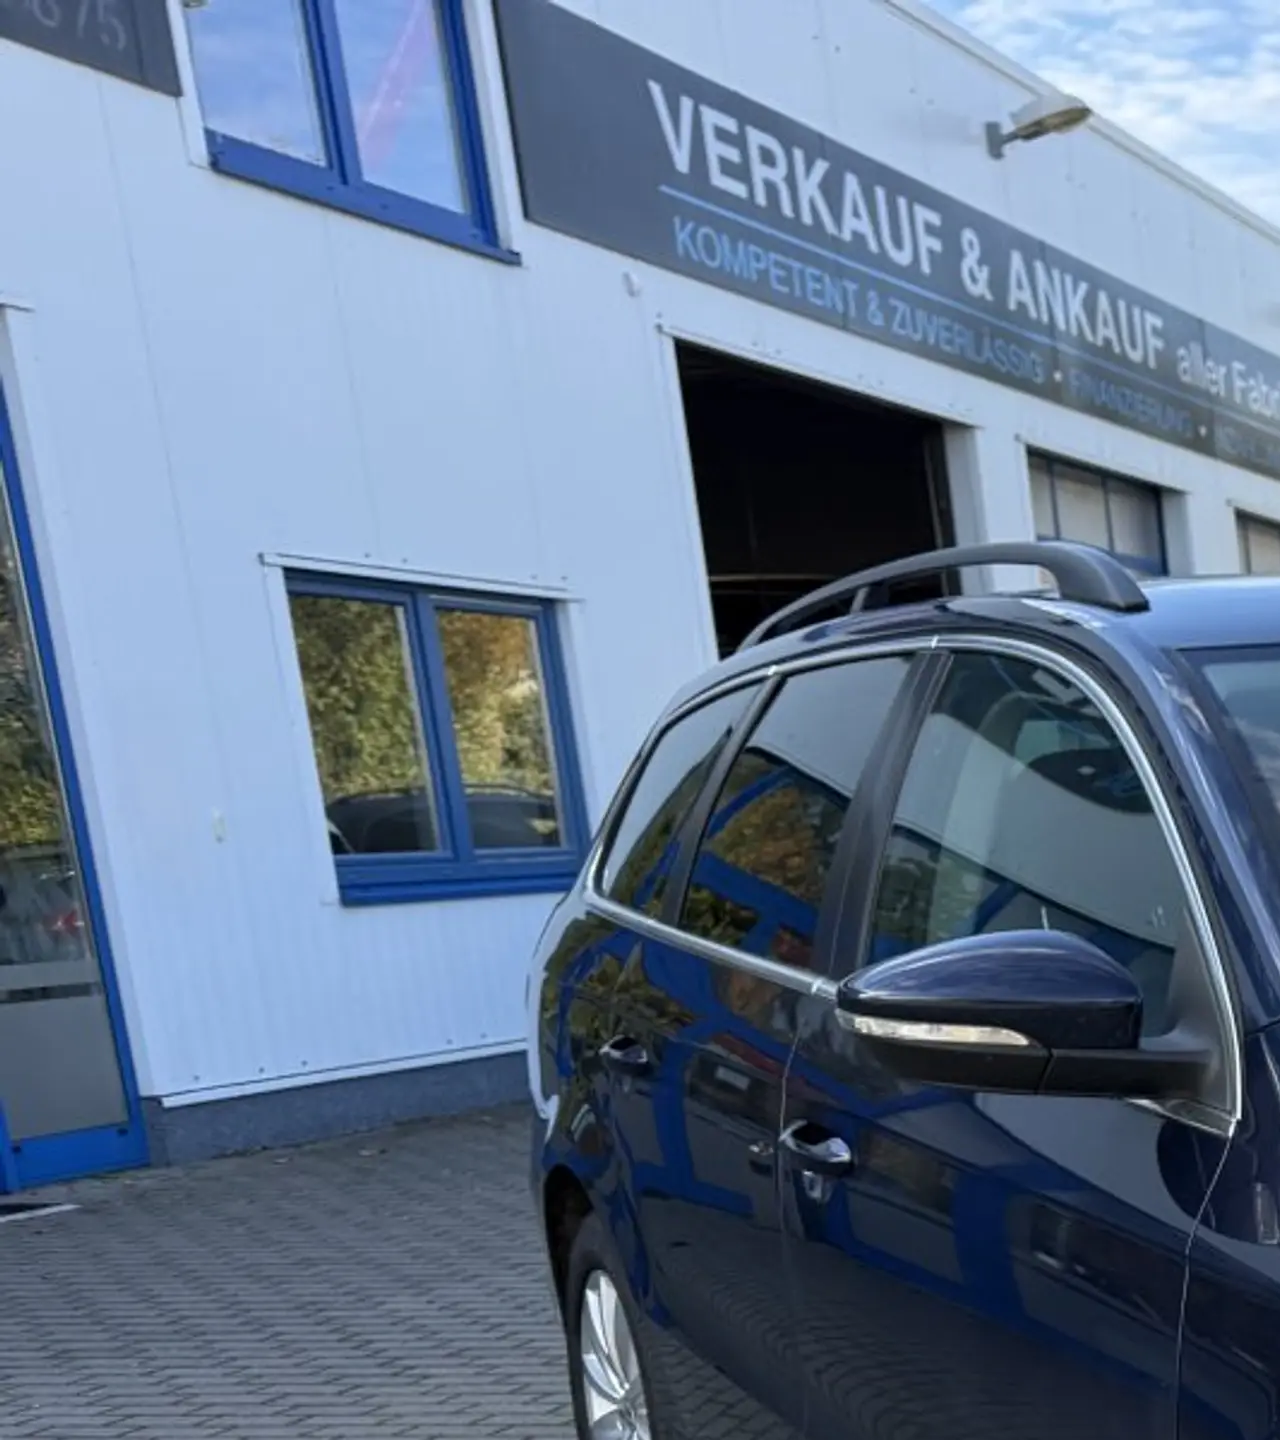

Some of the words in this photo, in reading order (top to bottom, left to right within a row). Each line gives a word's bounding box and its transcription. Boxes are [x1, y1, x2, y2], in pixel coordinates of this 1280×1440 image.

[647, 79, 943, 275] VERKAUF
[960, 227, 994, 302] &
[1007, 250, 1165, 370] ANKAUF
[1176, 340, 1227, 398] aller
[673, 215, 859, 318] KOMPETENT
[866, 289, 885, 327] &
